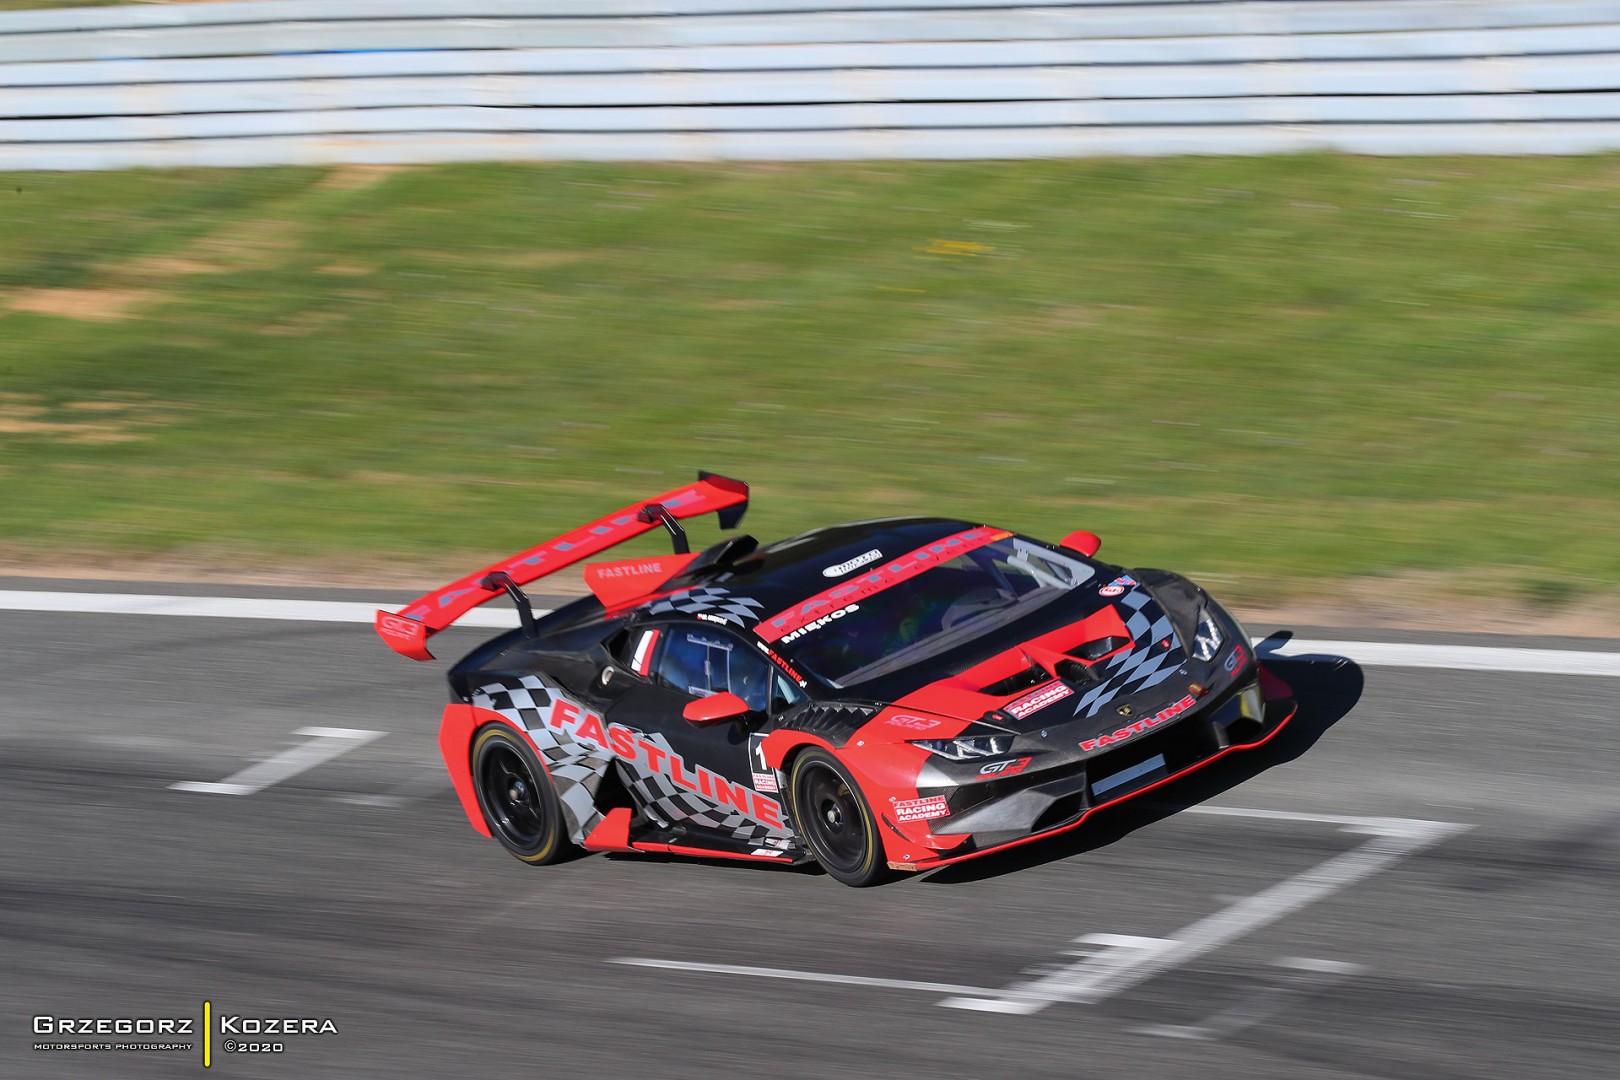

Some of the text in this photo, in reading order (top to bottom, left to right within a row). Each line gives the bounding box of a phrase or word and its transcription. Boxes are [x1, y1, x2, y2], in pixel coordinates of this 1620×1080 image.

[405, 489, 706, 620] FATLINE
[598, 563, 662, 578] FASTLINE
[771, 531, 990, 627] FASTLINE
[781, 604, 859, 644] MIĘKOS
[1011, 685, 1067, 714] RACING
[1018, 690, 1069, 717] ACADEMY
[891, 714, 941, 728] GT3
[1079, 694, 1197, 751] FASTLINE
[549, 698, 784, 830] FASTLINE
[980, 757, 1032, 774] GT3
[894, 795, 945, 807] FASTLINE
[896, 802, 946, 816] RACING
[899, 810, 947, 822] ACADEMY
